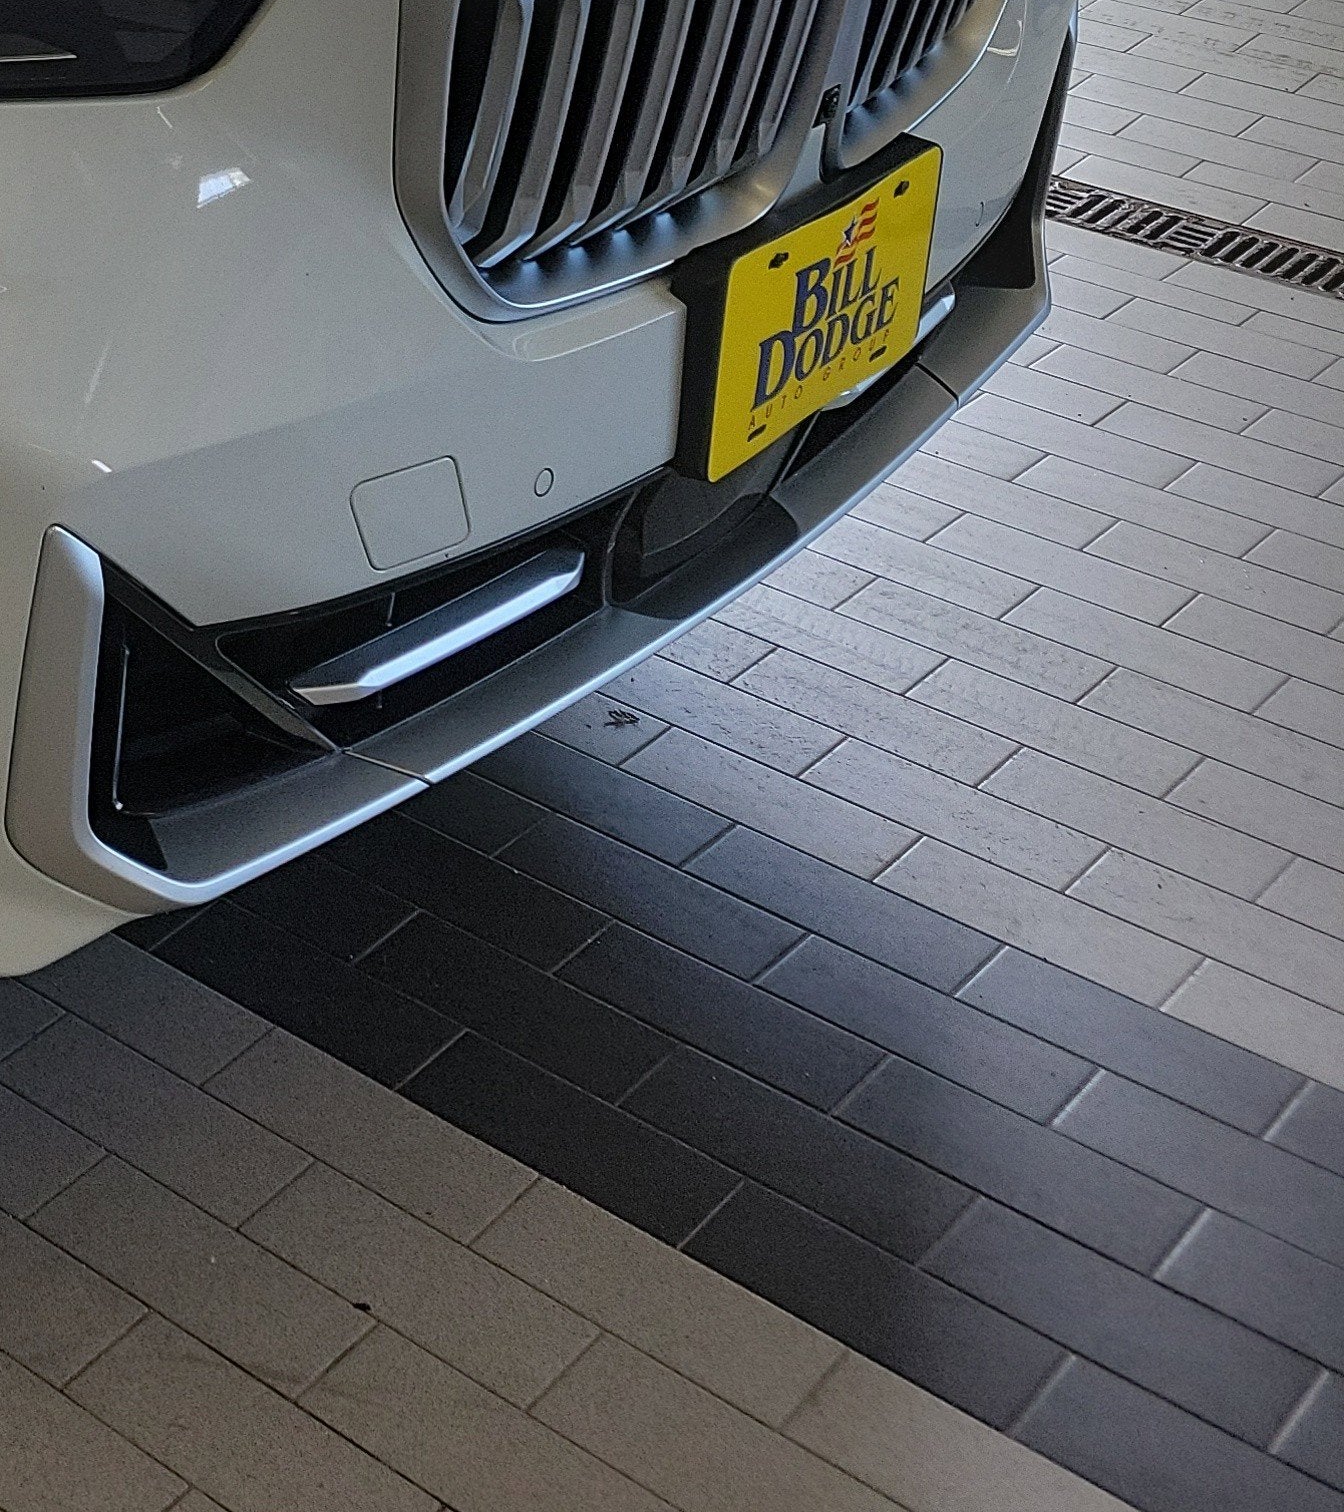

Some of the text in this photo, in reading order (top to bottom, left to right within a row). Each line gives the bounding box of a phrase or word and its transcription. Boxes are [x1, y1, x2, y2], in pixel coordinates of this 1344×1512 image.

[790, 244, 882, 337] BILL
[747, 327, 892, 431] AUTO GROUP
[750, 276, 902, 413] DODGE
